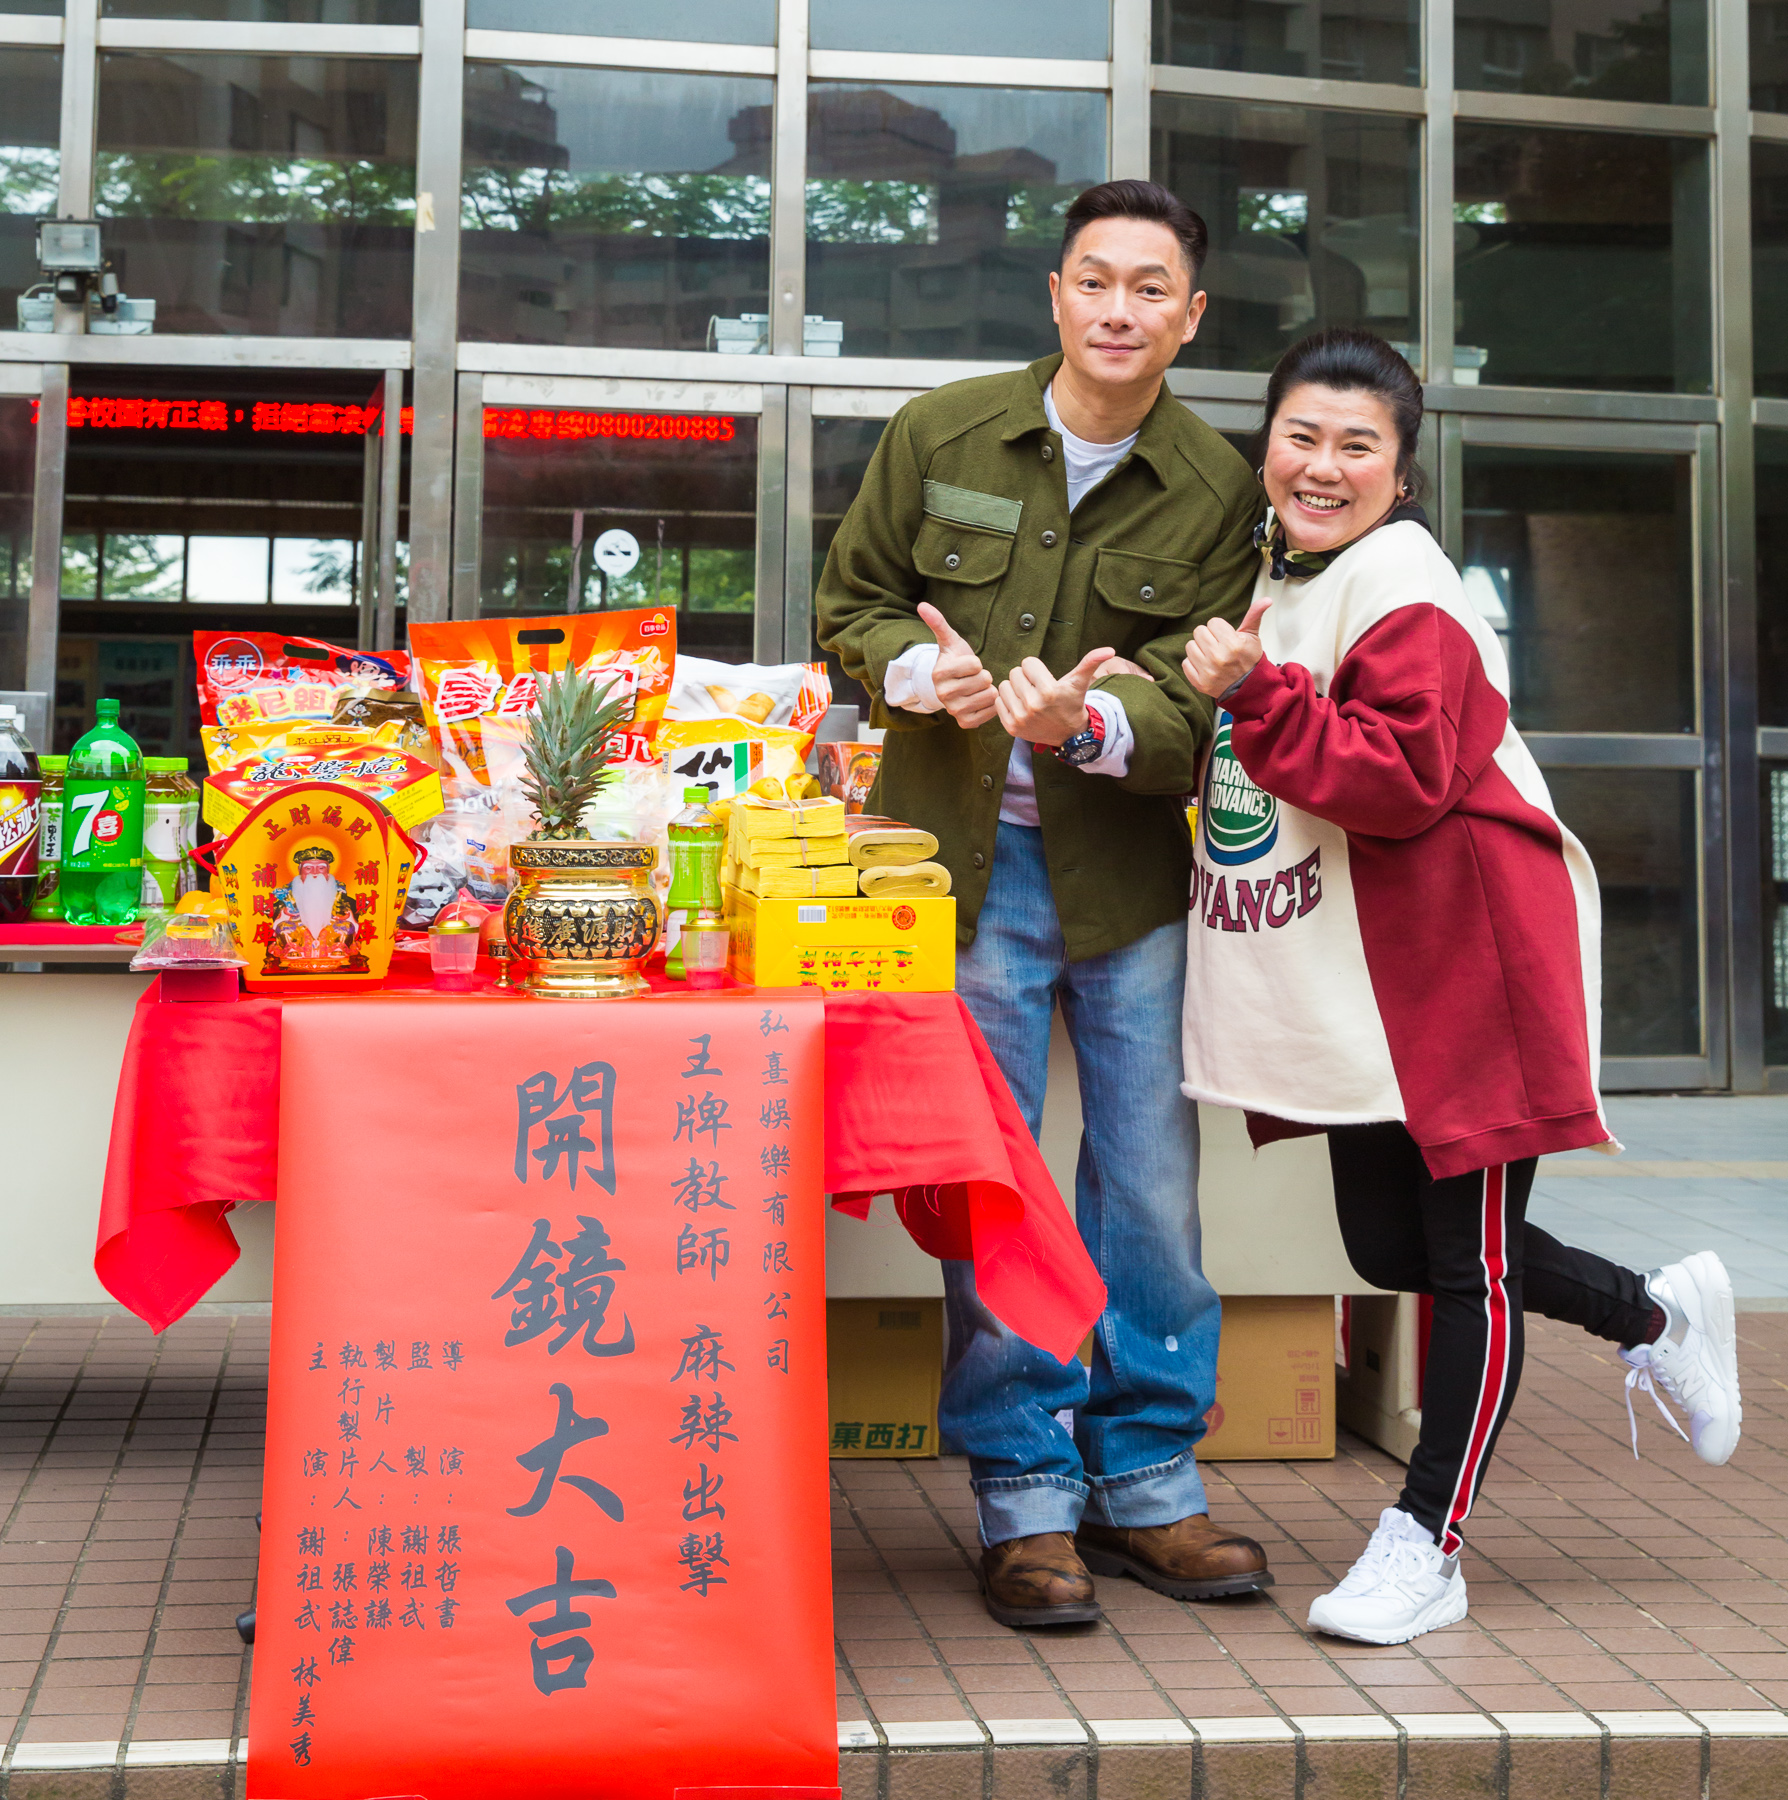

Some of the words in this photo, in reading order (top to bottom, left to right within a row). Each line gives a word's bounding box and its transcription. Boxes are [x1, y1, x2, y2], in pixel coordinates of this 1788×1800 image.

[210, 653, 258, 676] 乖乖
[45, 806, 61, 858] 茶裏王
[262, 803, 373, 841] 正財偏財
[1210, 782, 1266, 818] ADVANCE
[251, 862, 279, 947] 補財庫
[353, 860, 380, 946] 補財庫
[669, 1033, 737, 1282] 王牌教師
[759, 1009, 795, 1375] 弘熹娛樂有限公司
[490, 1060, 636, 1697] 開鏡大吉
[830, 1420, 929, 1450] 菓西打
[288, 1656, 322, 1768] 林美秀
